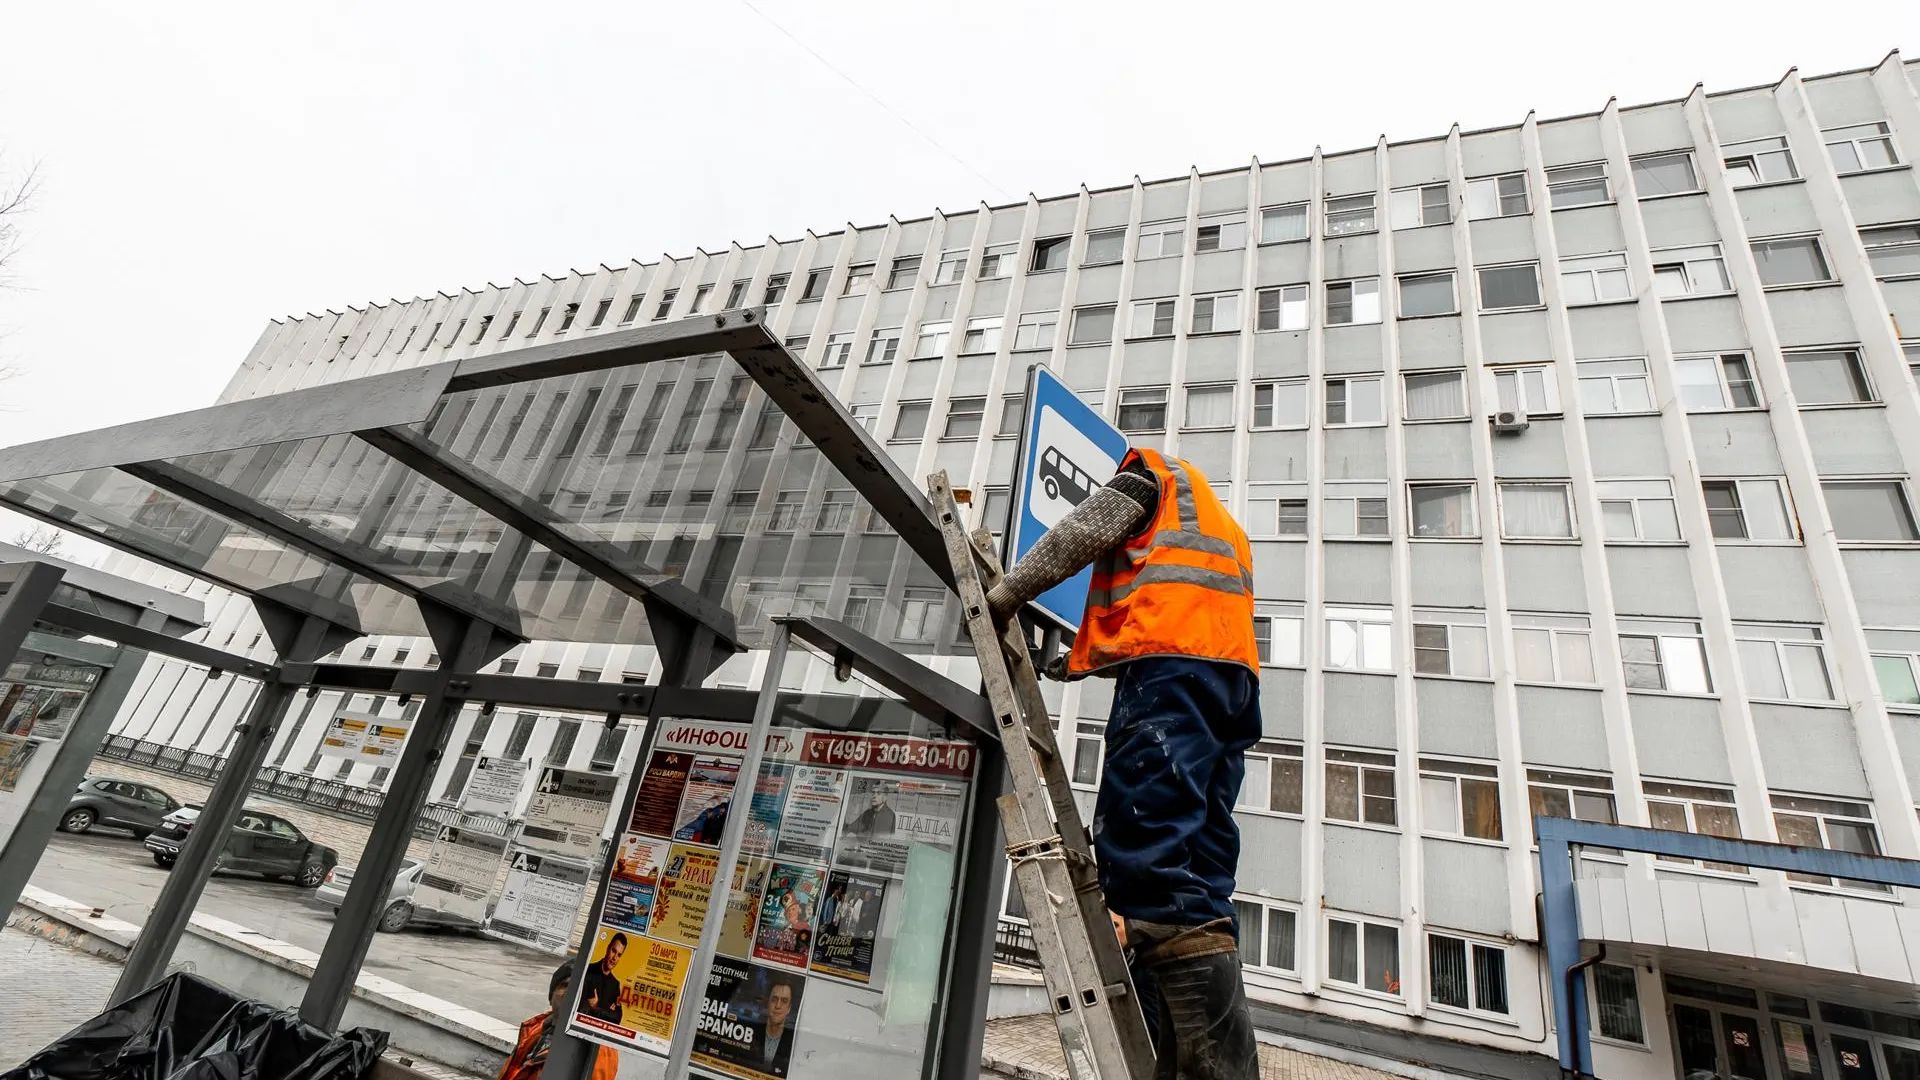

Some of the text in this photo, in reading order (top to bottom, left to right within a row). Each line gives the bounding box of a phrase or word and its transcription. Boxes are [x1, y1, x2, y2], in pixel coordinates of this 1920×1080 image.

[826, 738, 970, 771] (495) 308-30-10
[897, 814, 952, 838] ПАПА
[671, 856, 685, 871] 27
[766, 894, 780, 907] 31
[650, 943, 678, 960] 30 МАРТА
[733, 969, 749, 980] HALL
[634, 981, 677, 1001] ЕВГЕНИЙ
[701, 997, 729, 1018] ВАН
[697, 1014, 754, 1043] БРАМОВ
